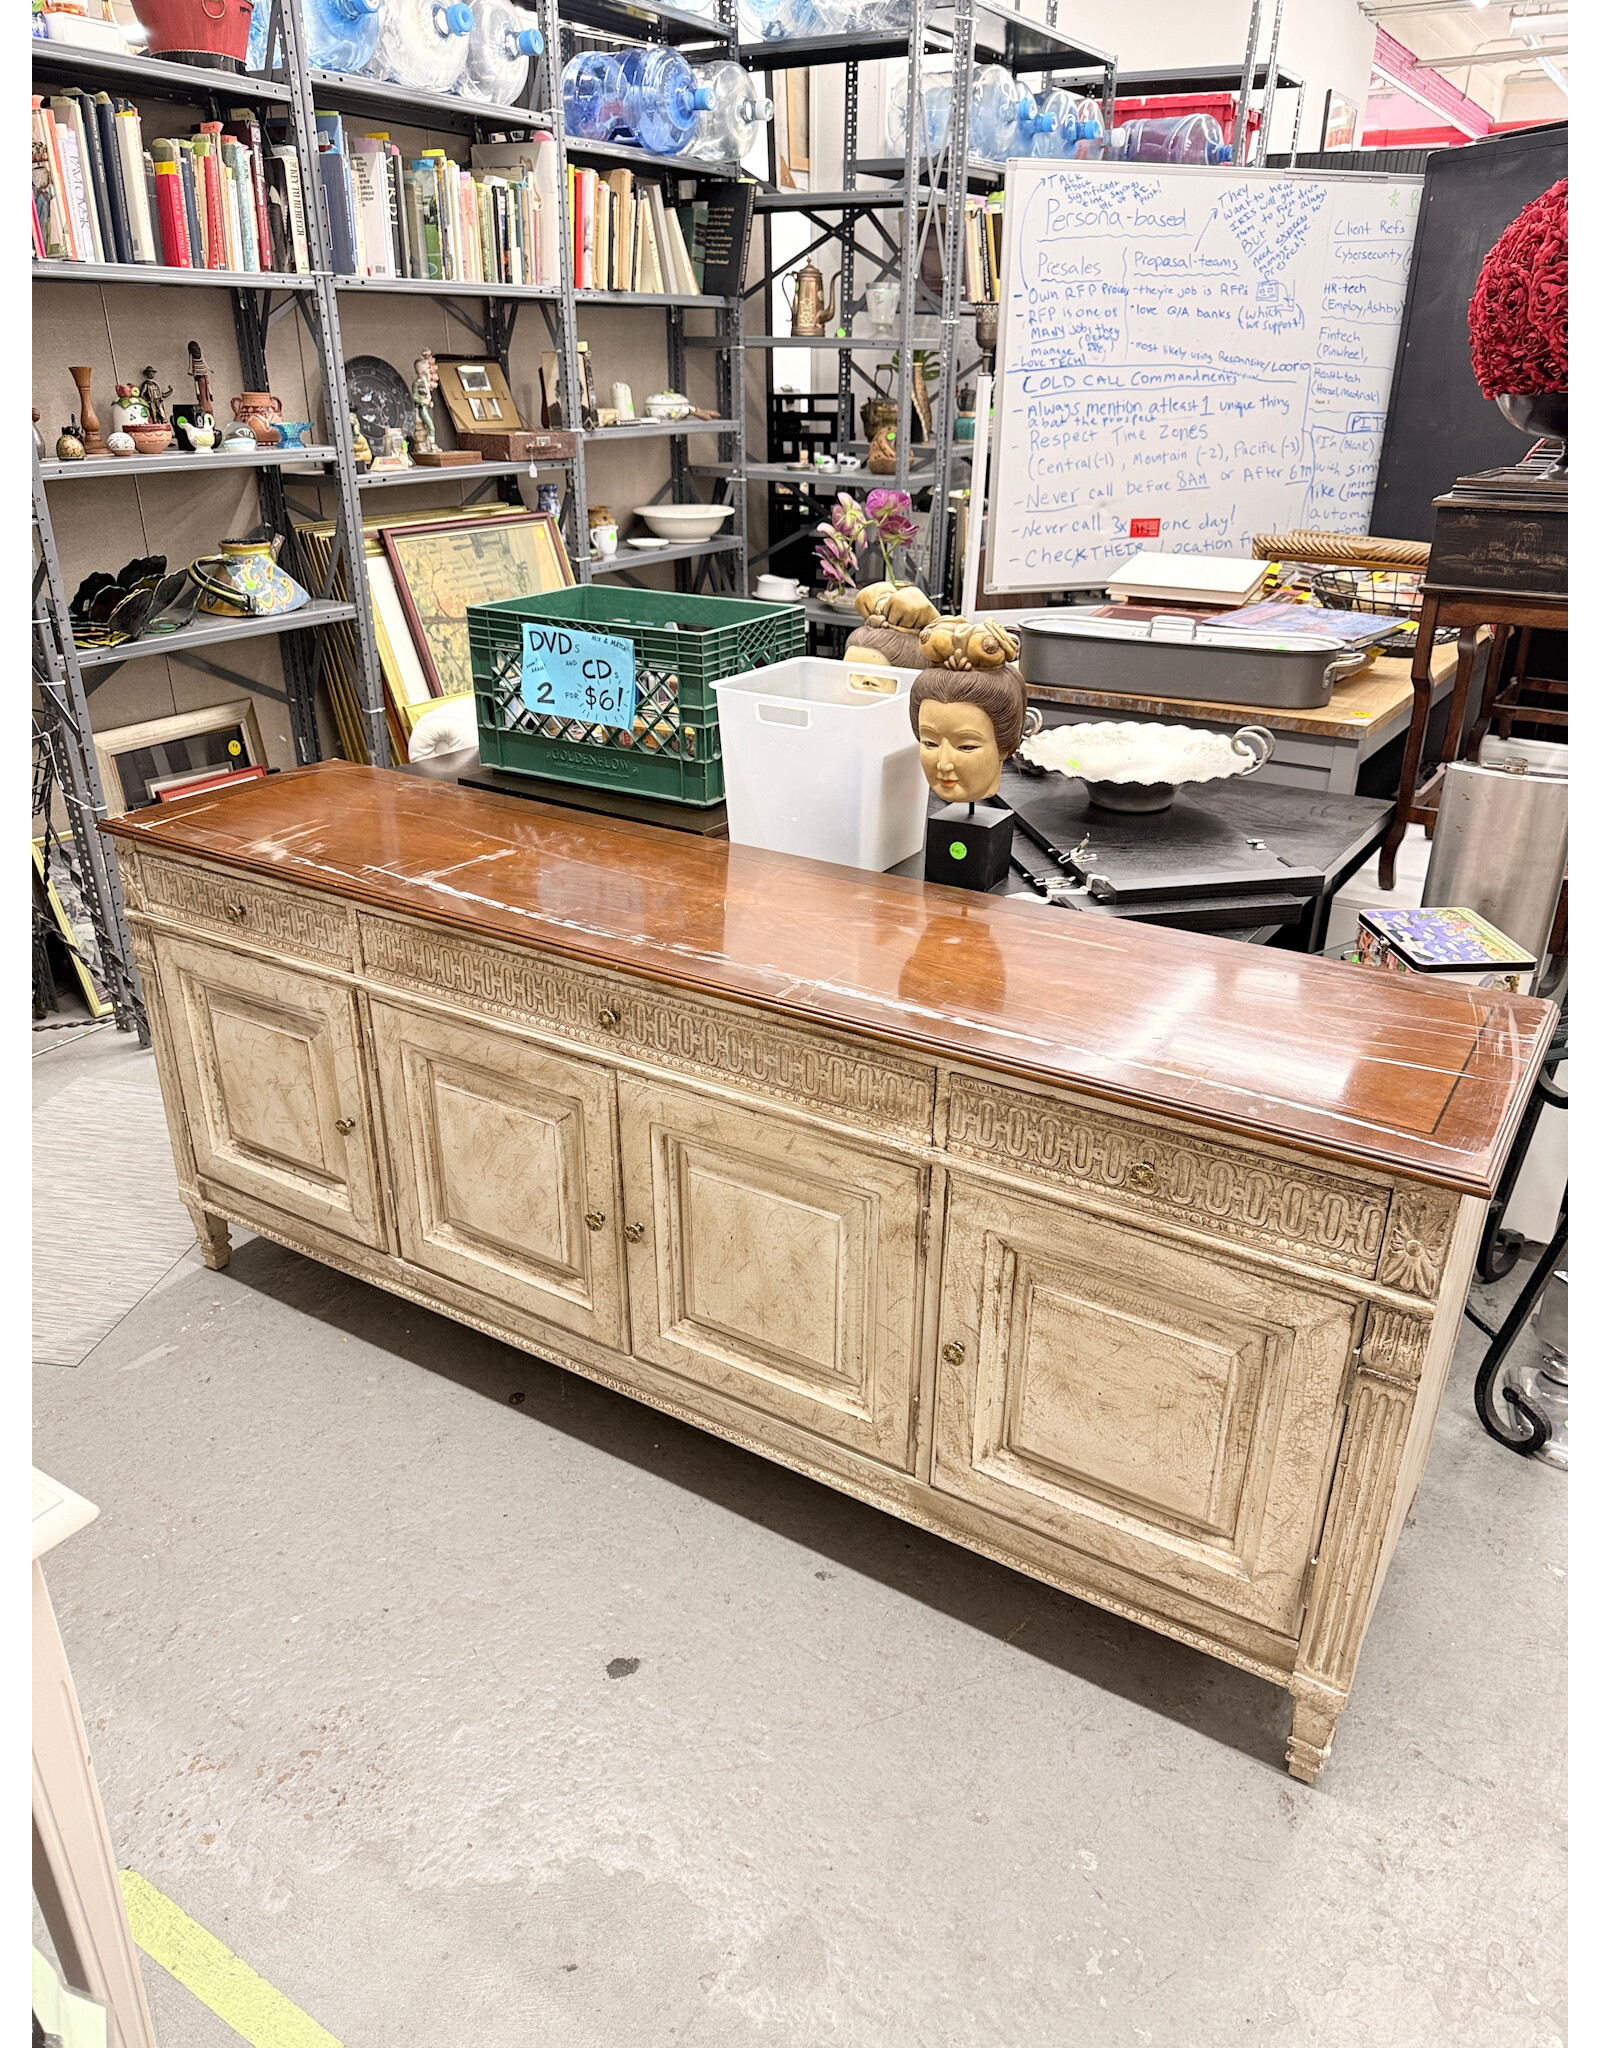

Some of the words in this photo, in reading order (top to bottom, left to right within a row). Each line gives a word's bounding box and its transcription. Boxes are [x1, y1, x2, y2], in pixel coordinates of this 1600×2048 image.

[94, 140, 100, 150] ON
[98, 165, 106, 183] MOON
[290, 169, 300, 185] KEY
[1048, 173, 1083, 189] TALK
[70, 156, 90, 229] PAVLOVSK
[292, 186, 300, 198] TO
[385, 159, 399, 226] VERDI
[1218, 184, 1249, 208] They
[292, 200, 305, 236] REBECCA
[1046, 198, 1188, 235] Persona-based
[1334, 219, 1372, 237] Client
[1380, 219, 1406, 236] Refs
[1038, 251, 1102, 278] Presales
[1028, 287, 1059, 305] Own
[1065, 283, 1097, 301] RFP
[1177, 285, 1198, 298] job
[1202, 286, 1213, 296] is
[1323, 282, 1367, 295] HR-tech
[1028, 306, 1056, 326] RFP
[1062, 307, 1073, 318] is
[1075, 308, 1101, 318] one
[1136, 303, 1159, 316] love
[1166, 305, 1190, 319] Q/A
[1196, 306, 1232, 320] banks
[1031, 326, 1066, 340] MANY
[1094, 322, 1120, 342] they
[1245, 321, 1260, 330] we
[1318, 326, 1361, 343] Fintech
[1030, 347, 1076, 360] manage
[1135, 340, 1159, 351] most
[1163, 345, 1188, 360] likely
[1190, 348, 1214, 364] using
[1022, 374, 1076, 394] COLD
[1082, 374, 1126, 388] CALL
[1027, 400, 1081, 420] Always
[1086, 399, 1143, 417] mention
[1201, 395, 1215, 416] 1
[1219, 401, 1256, 418] unique
[1259, 393, 1290, 416] thing
[1074, 415, 1098, 427] the
[1102, 413, 1157, 427] prospect
[1030, 428, 1098, 452] Respect
[1111, 425, 1147, 447] Time
[1159, 423, 1209, 441] Zones
[1133, 449, 1188, 466] Mountain
[1234, 440, 1277, 458] Pacific
[1026, 484, 1081, 509] Never
[1088, 482, 1114, 500] call
[1176, 470, 1208, 488] 8AM
[1220, 470, 1235, 481] or
[1243, 466, 1285, 484] After
[1289, 464, 1313, 482] 6PM
[1310, 484, 1336, 503] like
[1021, 519, 1069, 540] Never
[1072, 512, 1101, 533] call
[1111, 514, 1128, 535] 3x
[1161, 518, 1192, 532] one
[1198, 504, 1237, 537] day!
[1025, 543, 1089, 568] Check
[1089, 541, 1145, 562] THEIR
[529, 630, 580, 656] DVDs
[582, 659, 620, 680] CDs
[537, 681, 556, 705] 2
[565, 691, 580, 701] FOR
[585, 684, 624, 712] $6!
[551, 748, 631, 771] GOLDENFLOW
